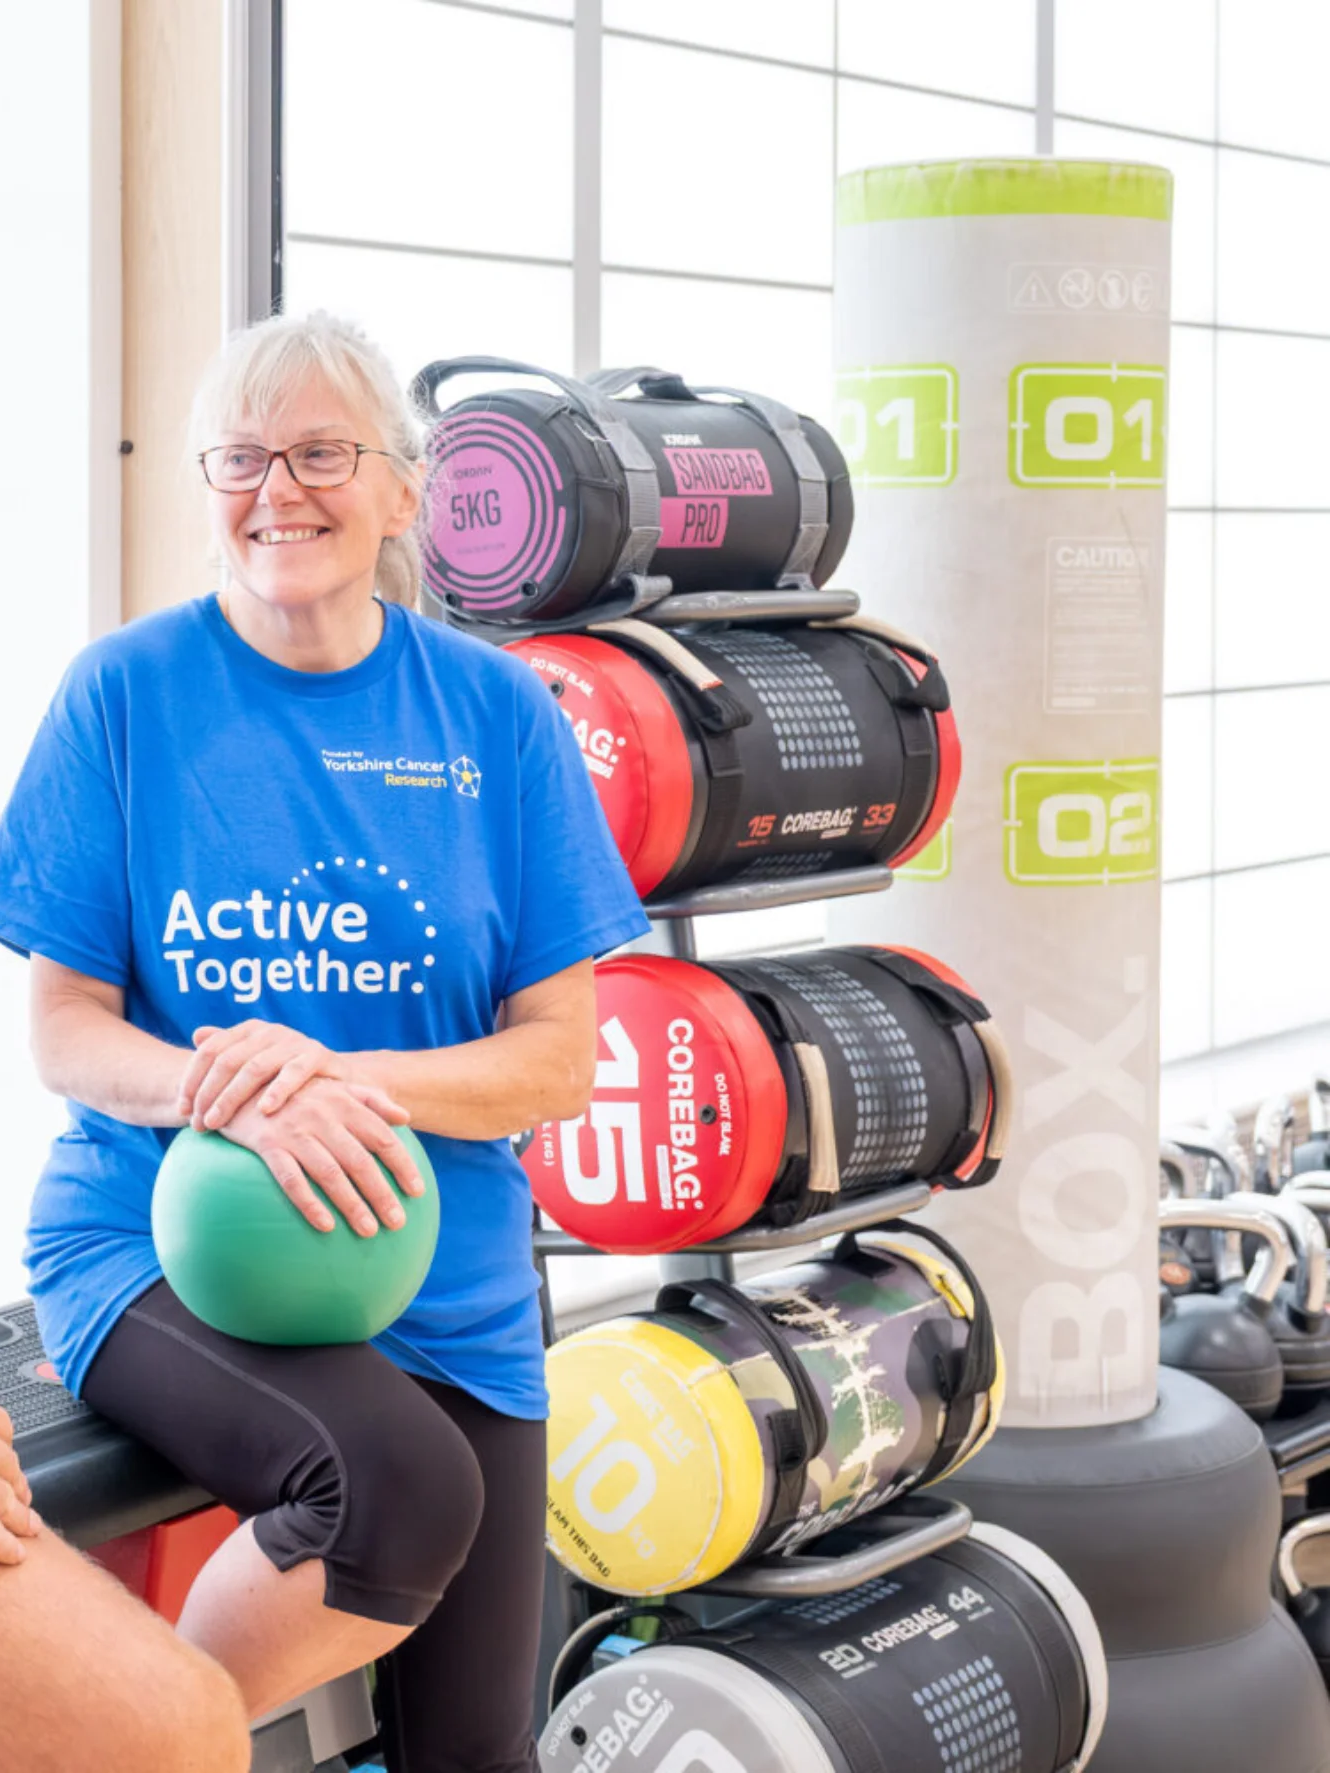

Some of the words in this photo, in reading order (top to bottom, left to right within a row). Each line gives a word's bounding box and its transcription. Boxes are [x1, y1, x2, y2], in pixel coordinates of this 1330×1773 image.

[1044, 396, 1153, 462] 01
[673, 452, 767, 490] SANDBAG
[451, 488, 502, 532] 5KG
[680, 502, 721, 544] PRO
[530, 657, 547, 670] DO
[546, 661, 568, 680] NOT
[322, 757, 393, 772] Yorkshire
[395, 756, 446, 772] Cancer
[384, 773, 448, 788] Research
[748, 814, 777, 838] 15
[862, 803, 897, 827] 33
[1037, 792, 1151, 858] 02
[162, 889, 368, 943] Active
[715, 1073, 728, 1093] DO
[719, 1094, 732, 1120] NOT
[550, 1392, 658, 1535] 10
[818, 1643, 865, 1672] 20
[947, 1585, 985, 1611] 44
